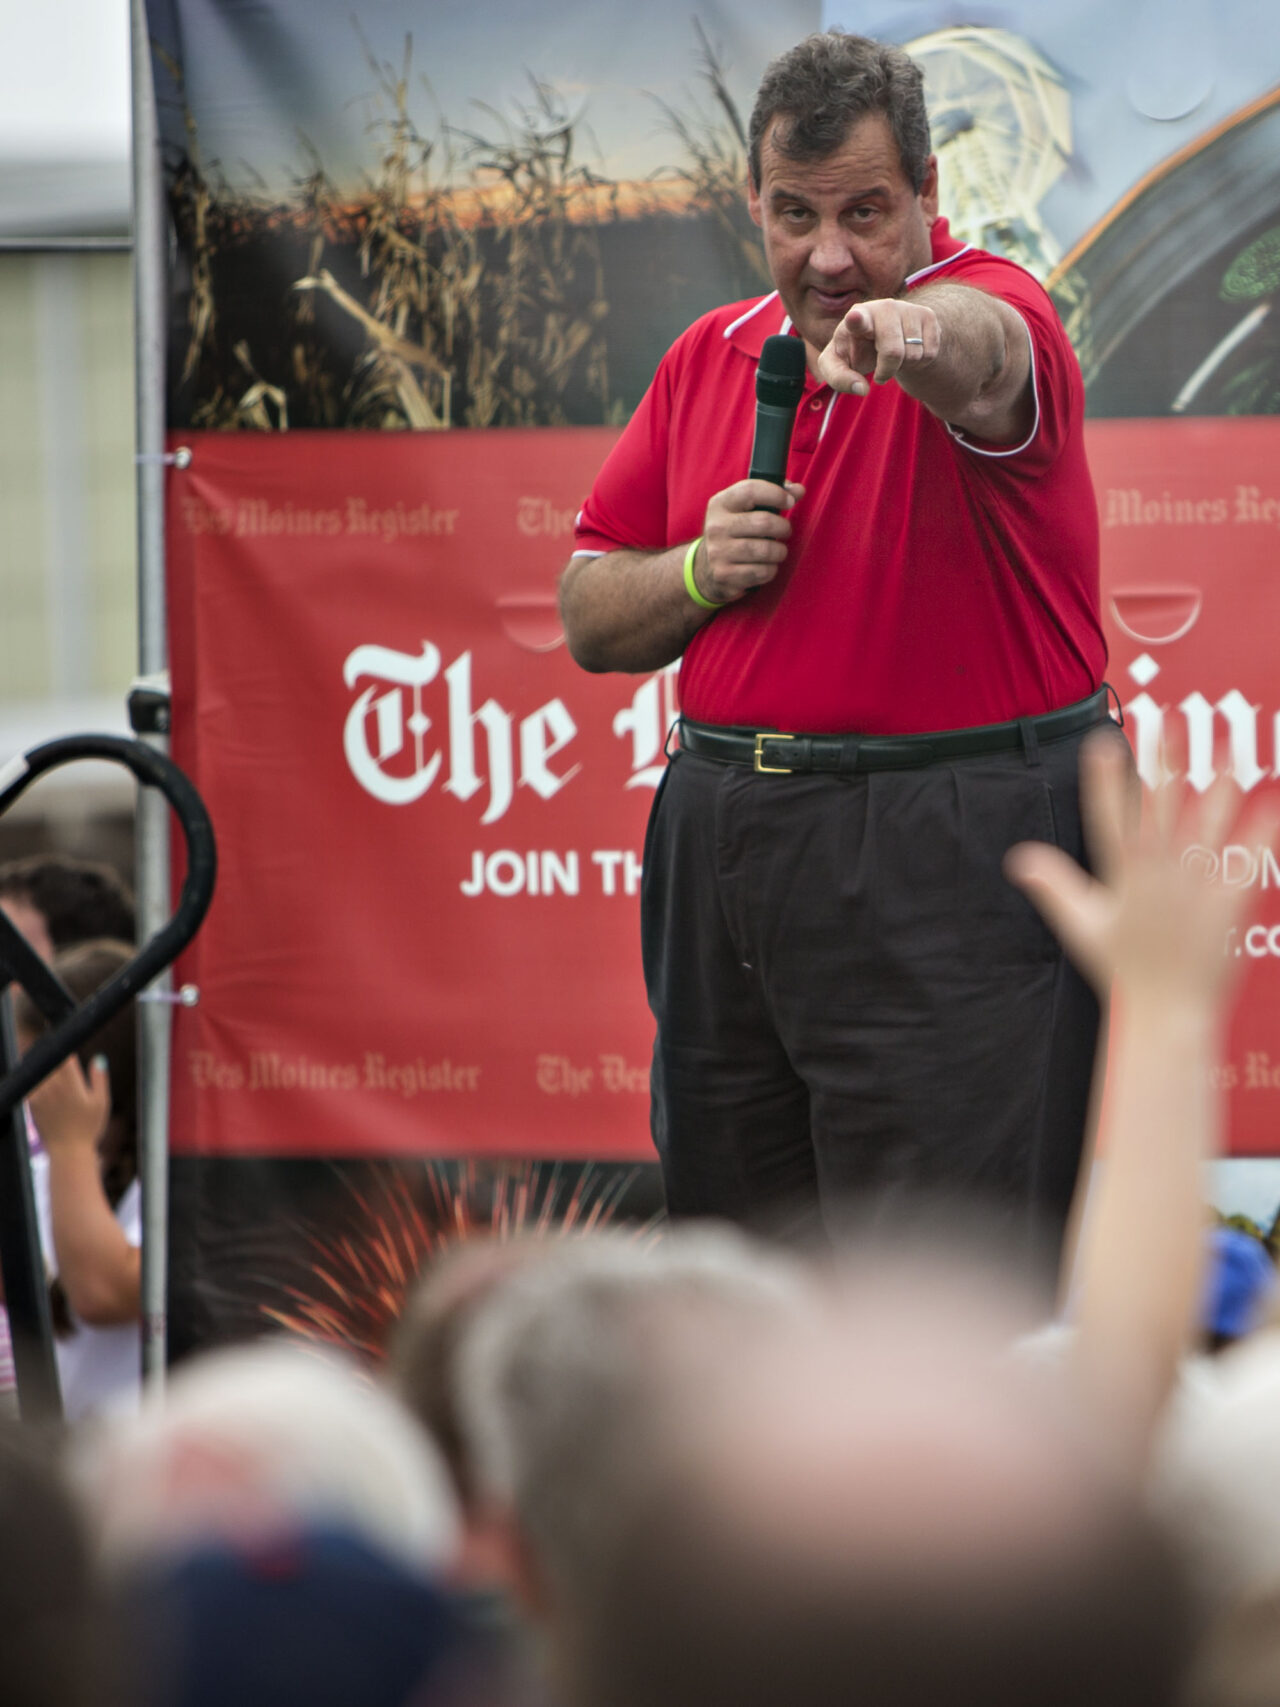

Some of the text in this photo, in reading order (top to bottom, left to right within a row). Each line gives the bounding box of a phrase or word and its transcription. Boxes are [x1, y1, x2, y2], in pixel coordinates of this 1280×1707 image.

[235, 497, 342, 538] Moines
[345, 495, 459, 542] Register
[517, 496, 576, 538] The
[1103, 488, 1229, 528] Moines
[343, 640, 581, 825] The
[459, 850, 643, 897] JOIN TH
[187, 1051, 482, 1097] Des Moines Register
[536, 1054, 650, 1095] The Des
